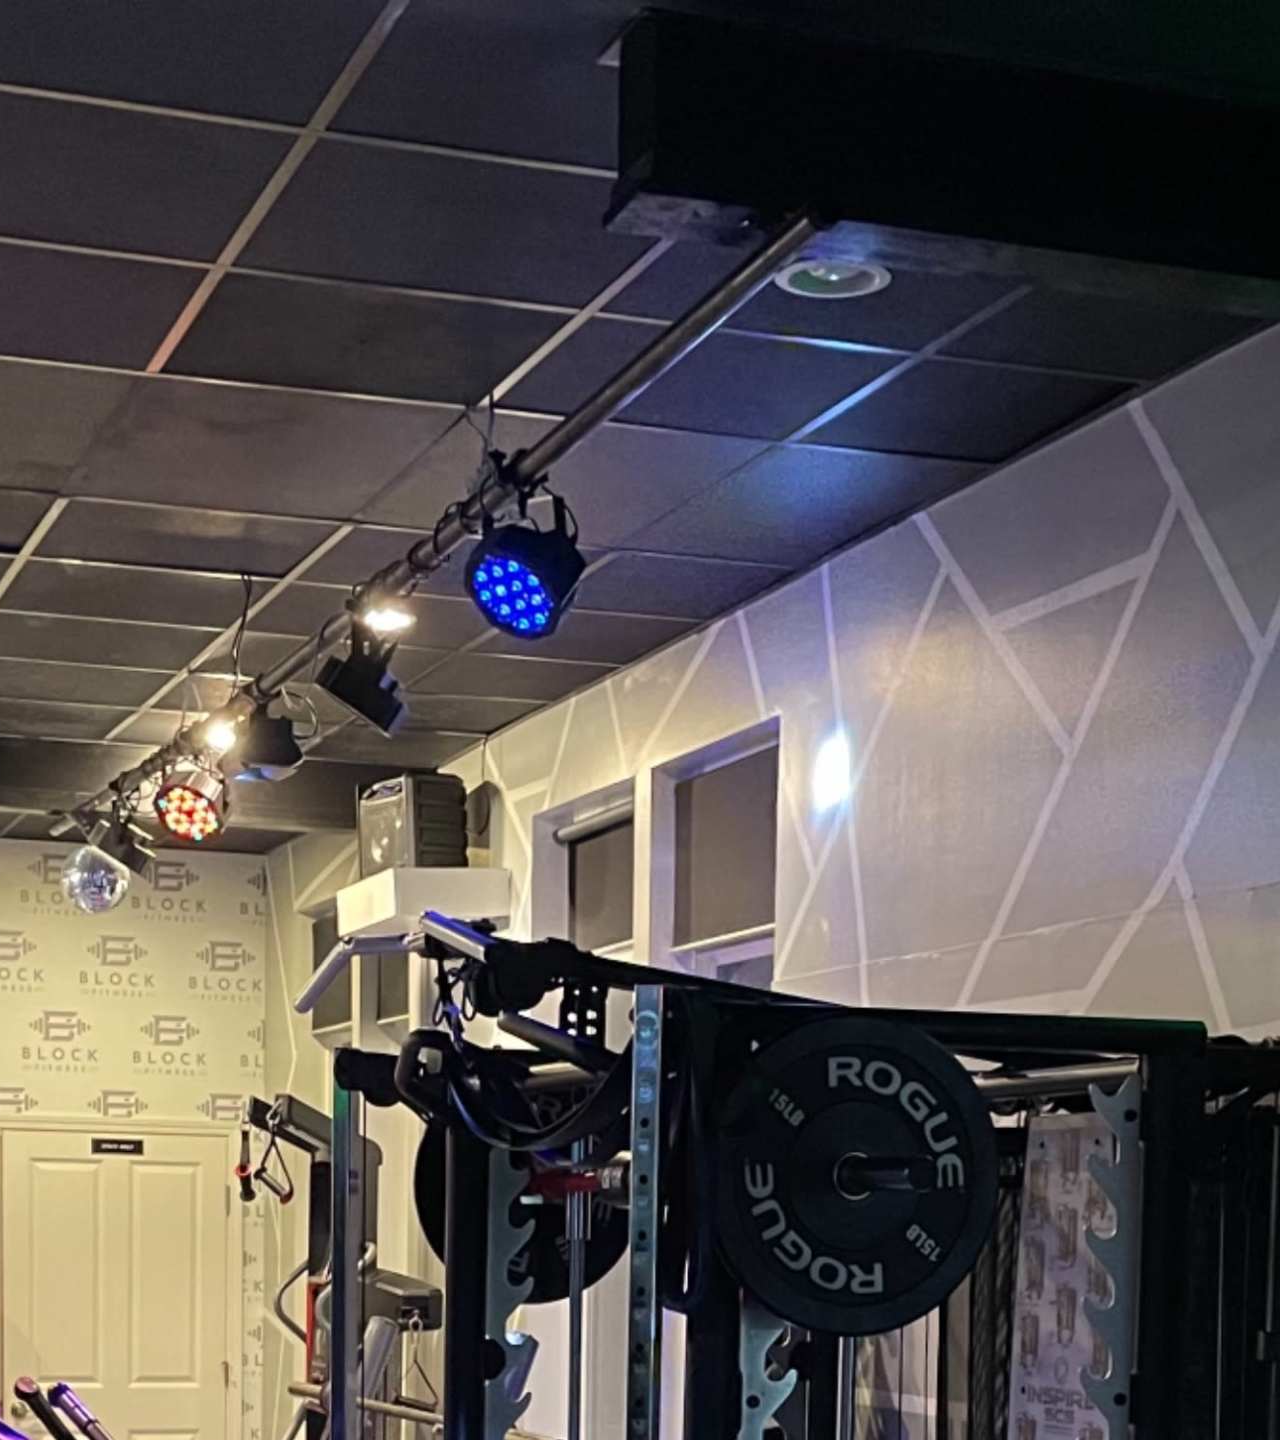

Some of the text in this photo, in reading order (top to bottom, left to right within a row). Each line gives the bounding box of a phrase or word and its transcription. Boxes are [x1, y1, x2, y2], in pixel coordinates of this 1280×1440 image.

[132, 897, 207, 913] BLOCK
[80, 971, 155, 987] BLOCK
[188, 976, 263, 991] BLOCK
[22, 1047, 98, 1062] BLOCK
[132, 1051, 206, 1065] BLOCK
[768, 1088, 806, 1127] 15LB
[827, 1055, 965, 1190] ROGUE
[744, 1157, 884, 1296] ROGUE
[905, 1224, 942, 1263] 15LB
